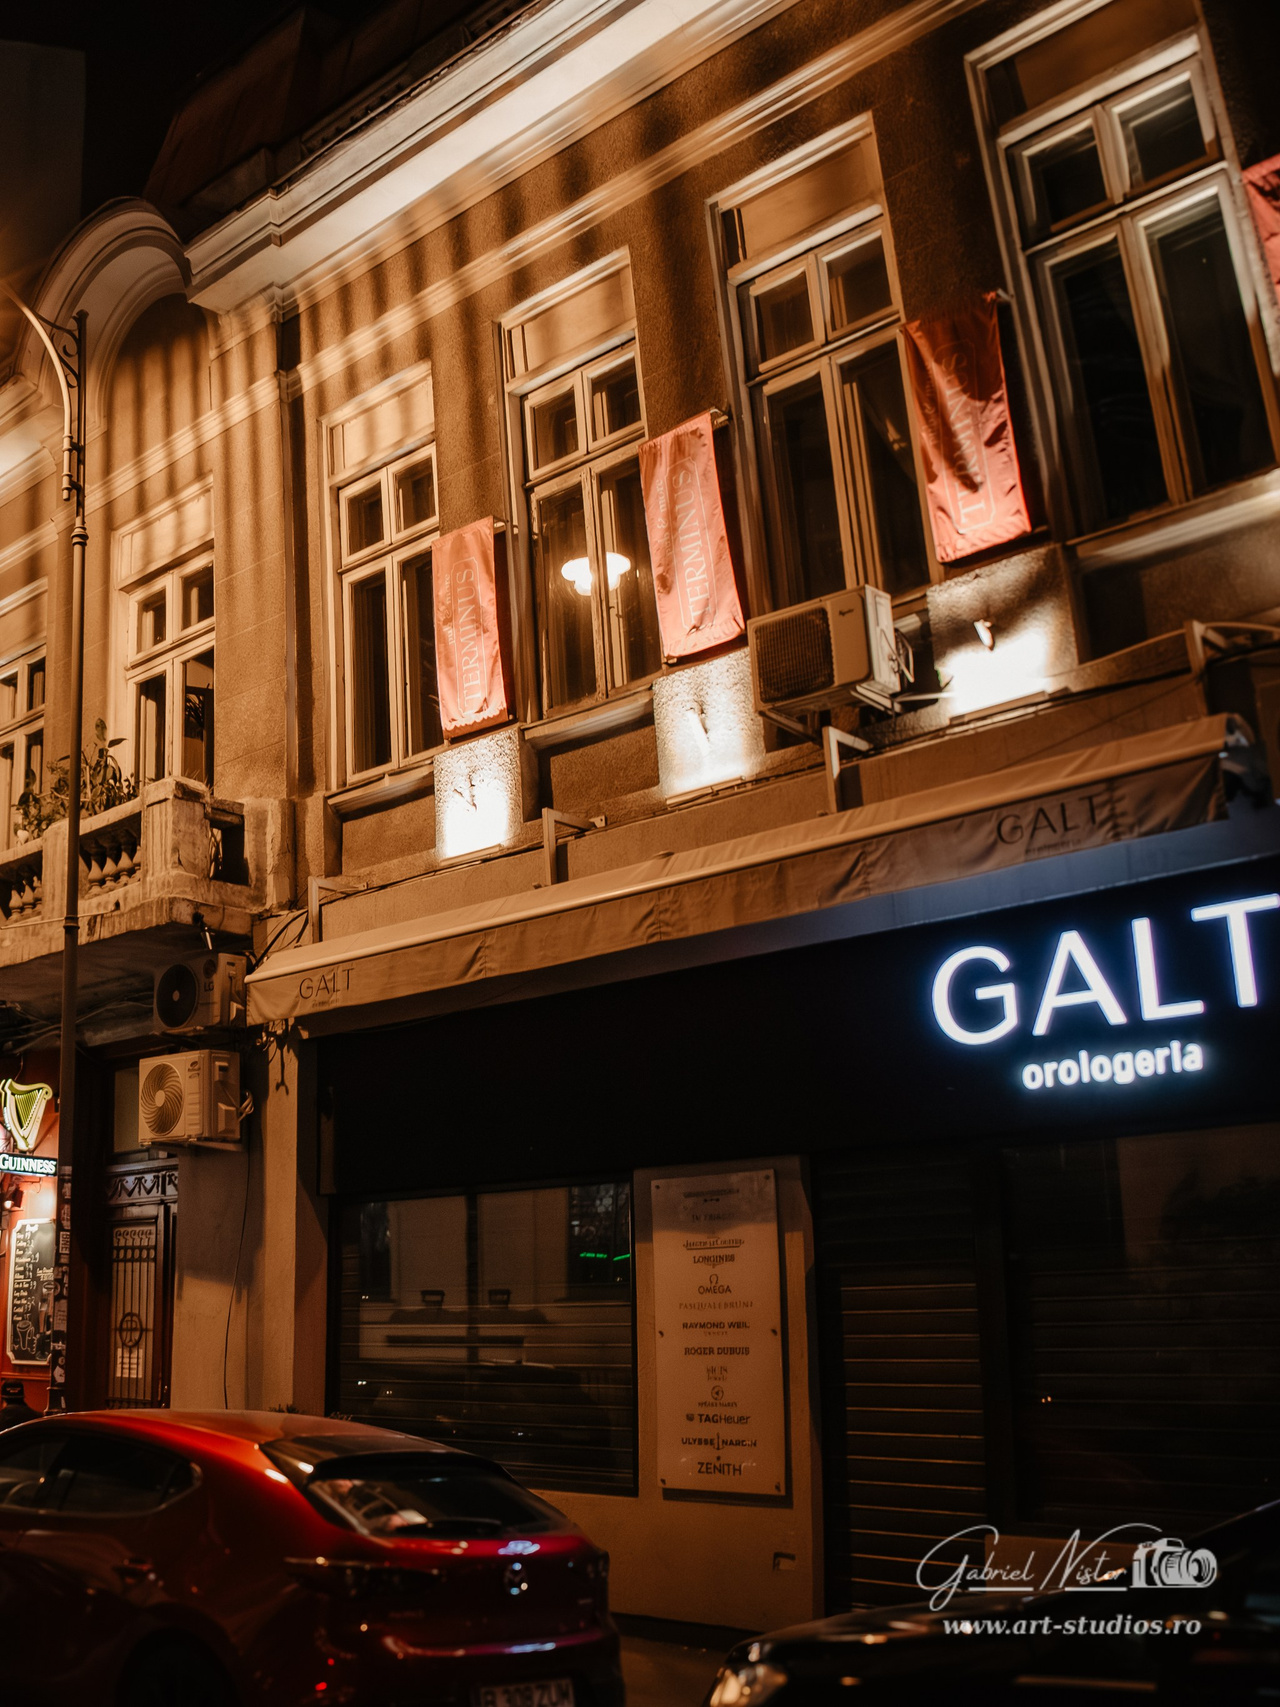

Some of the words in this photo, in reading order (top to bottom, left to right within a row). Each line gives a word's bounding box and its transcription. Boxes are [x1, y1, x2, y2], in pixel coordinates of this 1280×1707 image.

[673, 470, 710, 625] TERMINUS
[457, 568, 482, 706] TERMINUS
[997, 789, 1106, 844] GALT
[932, 893, 1280, 1045] GALT
[203, 981, 214, 993] LG
[299, 968, 355, 999] GALT
[1021, 1040, 1205, 1090] orologeria
[693, 1253, 735, 1264] LONGINES
[698, 1285, 731, 1294] OMEGA
[682, 1321, 725, 1329] RAYMOND
[727, 1321, 750, 1329] WEIL
[684, 1347, 715, 1355] ROGER
[717, 1347, 749, 1355] DUBUIS
[681, 1438, 715, 1446] ULYSSE
[697, 1462, 742, 1476] ZENITH
